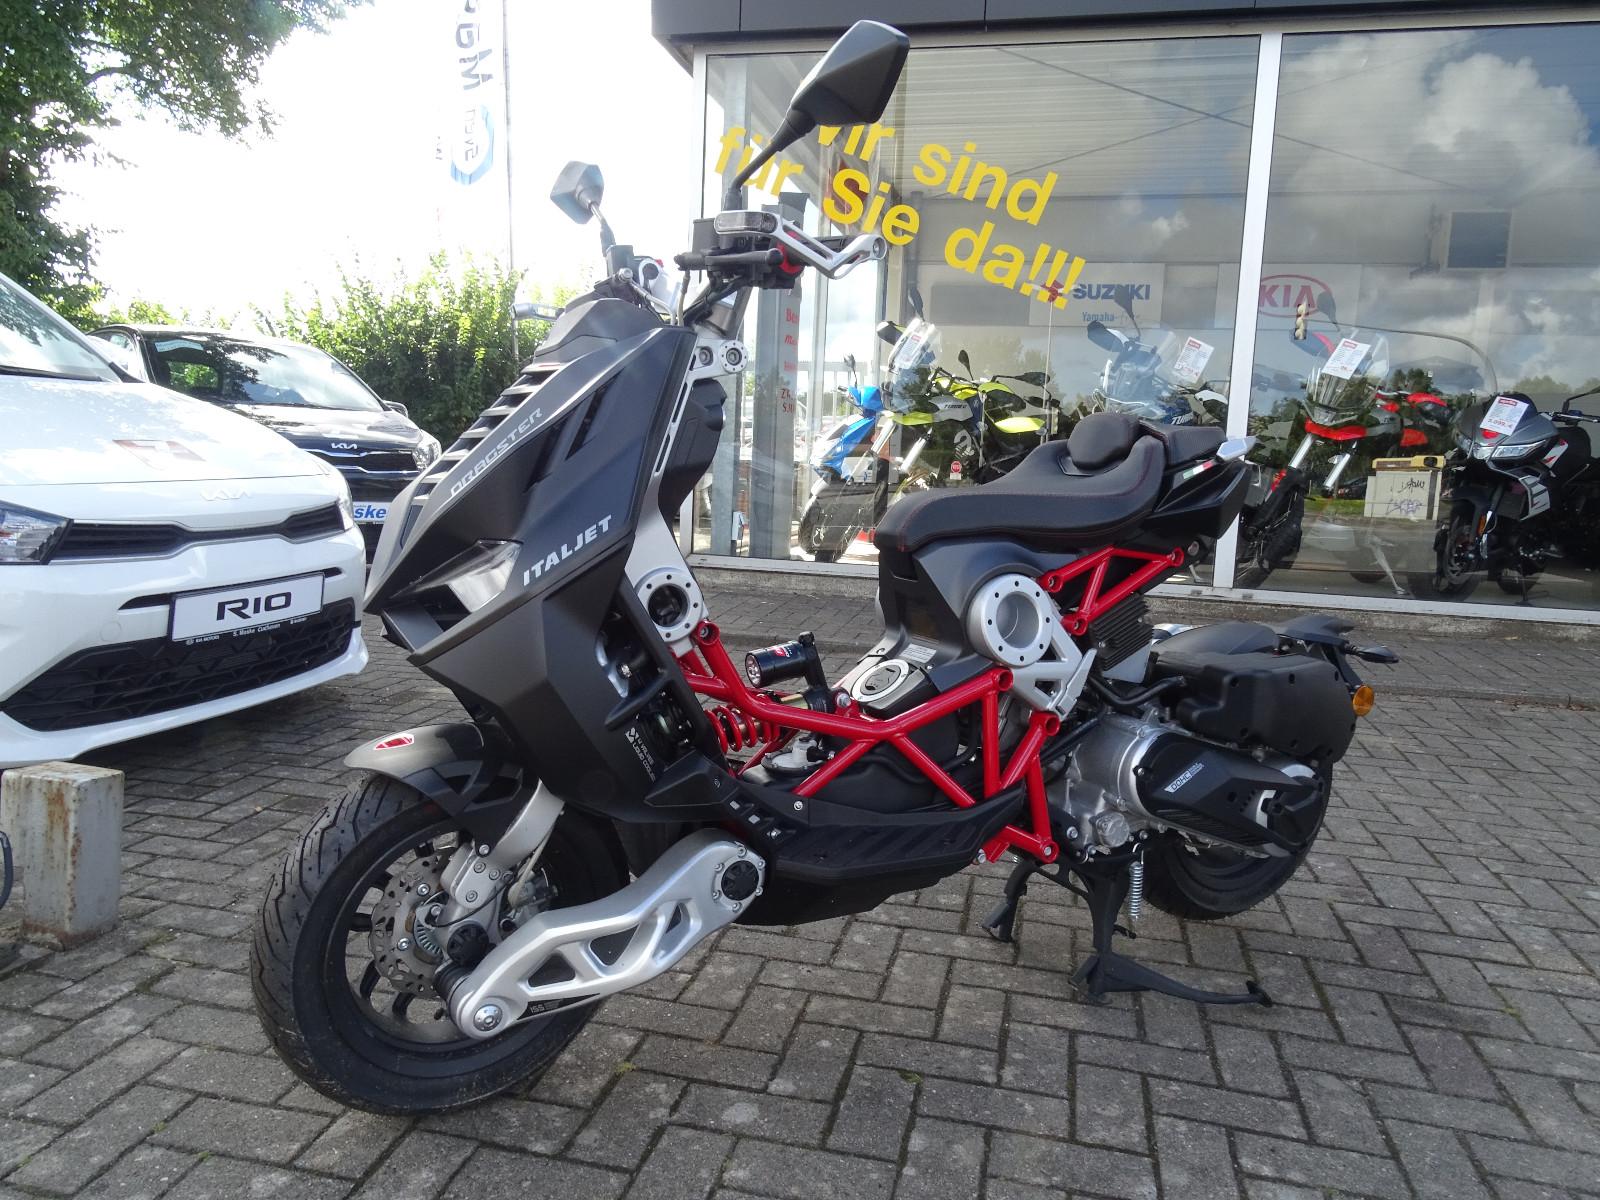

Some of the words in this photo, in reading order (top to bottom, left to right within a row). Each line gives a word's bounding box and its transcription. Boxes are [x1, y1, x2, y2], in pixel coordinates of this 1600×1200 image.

[817, 121, 896, 161] ir
[912, 140, 1059, 225] sind
[714, 123, 805, 197] für
[823, 168, 920, 246] Sie
[944, 220, 1087, 310] da!!!
[1072, 283, 1151, 300] SUZKI
[1259, 284, 1316, 308] KIA
[450, 407, 543, 497] DRAGSTER
[354, 504, 387, 519] ske
[523, 514, 612, 587] ITALJET
[216, 591, 292, 621] RIO
